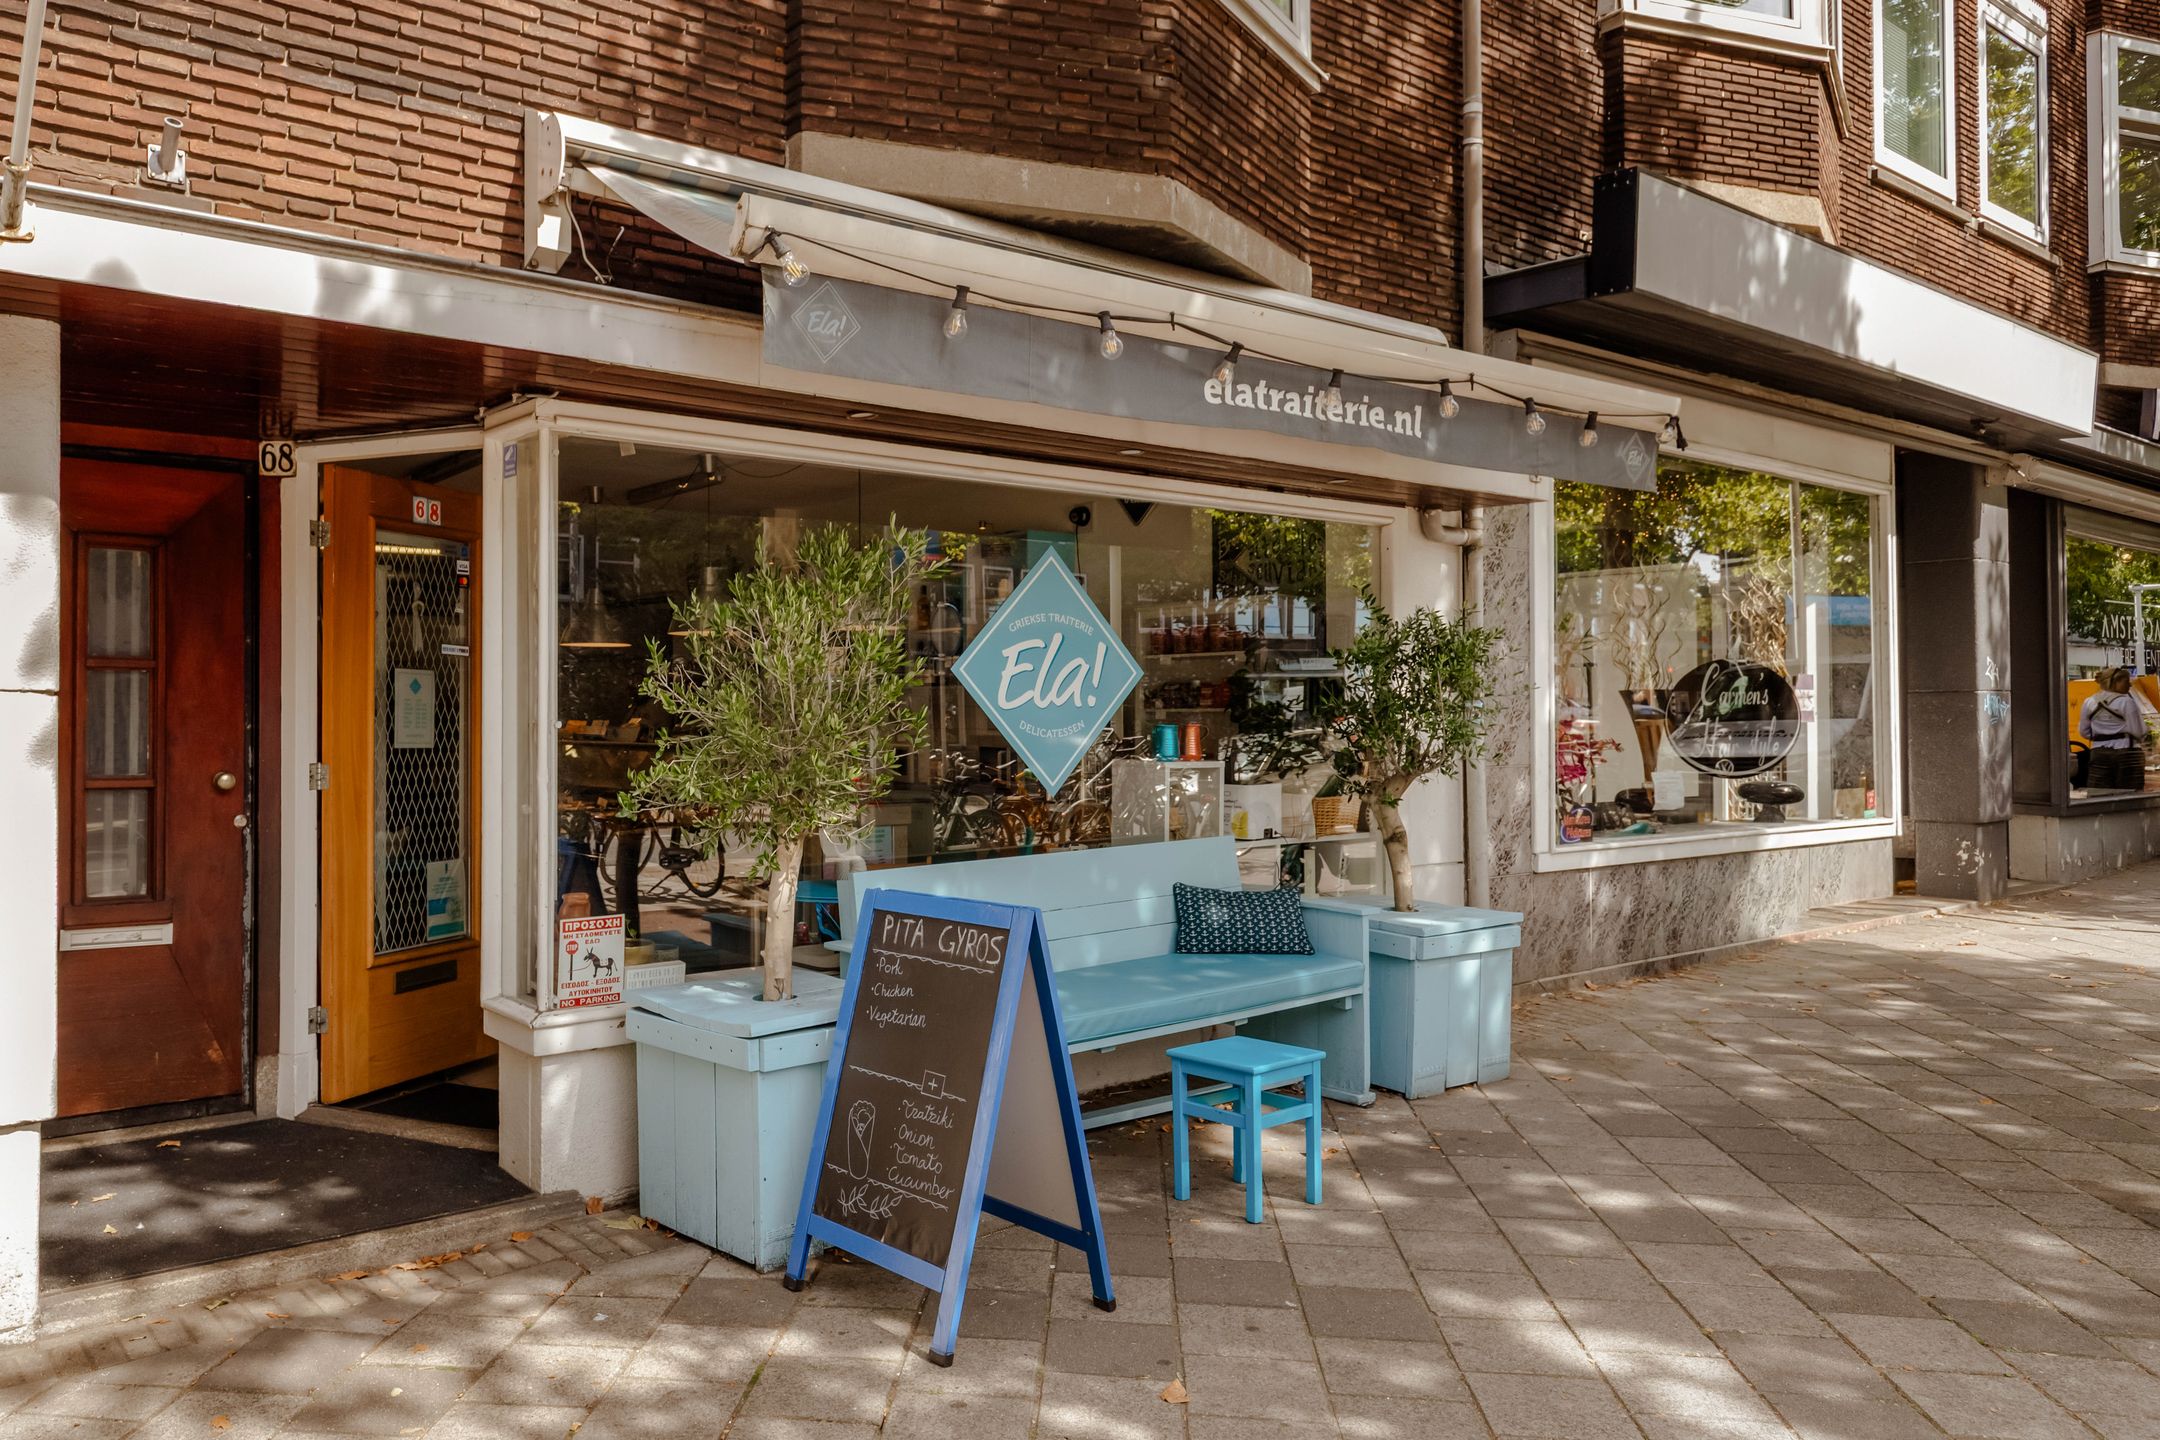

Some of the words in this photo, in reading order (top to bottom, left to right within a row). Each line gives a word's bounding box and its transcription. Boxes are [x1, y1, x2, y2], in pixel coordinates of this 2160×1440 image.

[807, 310, 847, 337] Ela!
[1203, 378, 1423, 439] elatraiterie.nl
[261, 443, 294, 473] 68
[415, 500, 440, 522] 68
[1008, 613, 1047, 633] GRIEKSE
[1047, 613, 1095, 636] TRAITERIE
[997, 632, 1108, 710] Ela!
[1701, 662, 1769, 707] Carmen's
[1019, 720, 1086, 738] DELICATESSEN
[565, 917, 621, 932] ΠΡΟΣΟΧΗ
[566, 943, 578, 952] STOP
[882, 914, 924, 949] PITA
[938, 925, 1005, 966] GYROS
[878, 957, 903, 975] Pork
[561, 980, 589, 989] ΕΙΣΟΔΟΣ
[595, 976, 621, 985] ΕΞΟΔΟΣ
[568, 986, 613, 997] ΑΥΤΟΚΙΝΗΤΟΥ
[874, 982, 914, 997] Chicken
[561, 999, 575, 1007] NO
[580, 993, 619, 1004] PARKING
[870, 1005, 927, 1029] Vegetarian
[898, 1123, 935, 1150] Onion
[893, 1142, 943, 1175] Tomato
[888, 1165, 955, 1200] Cucumber
